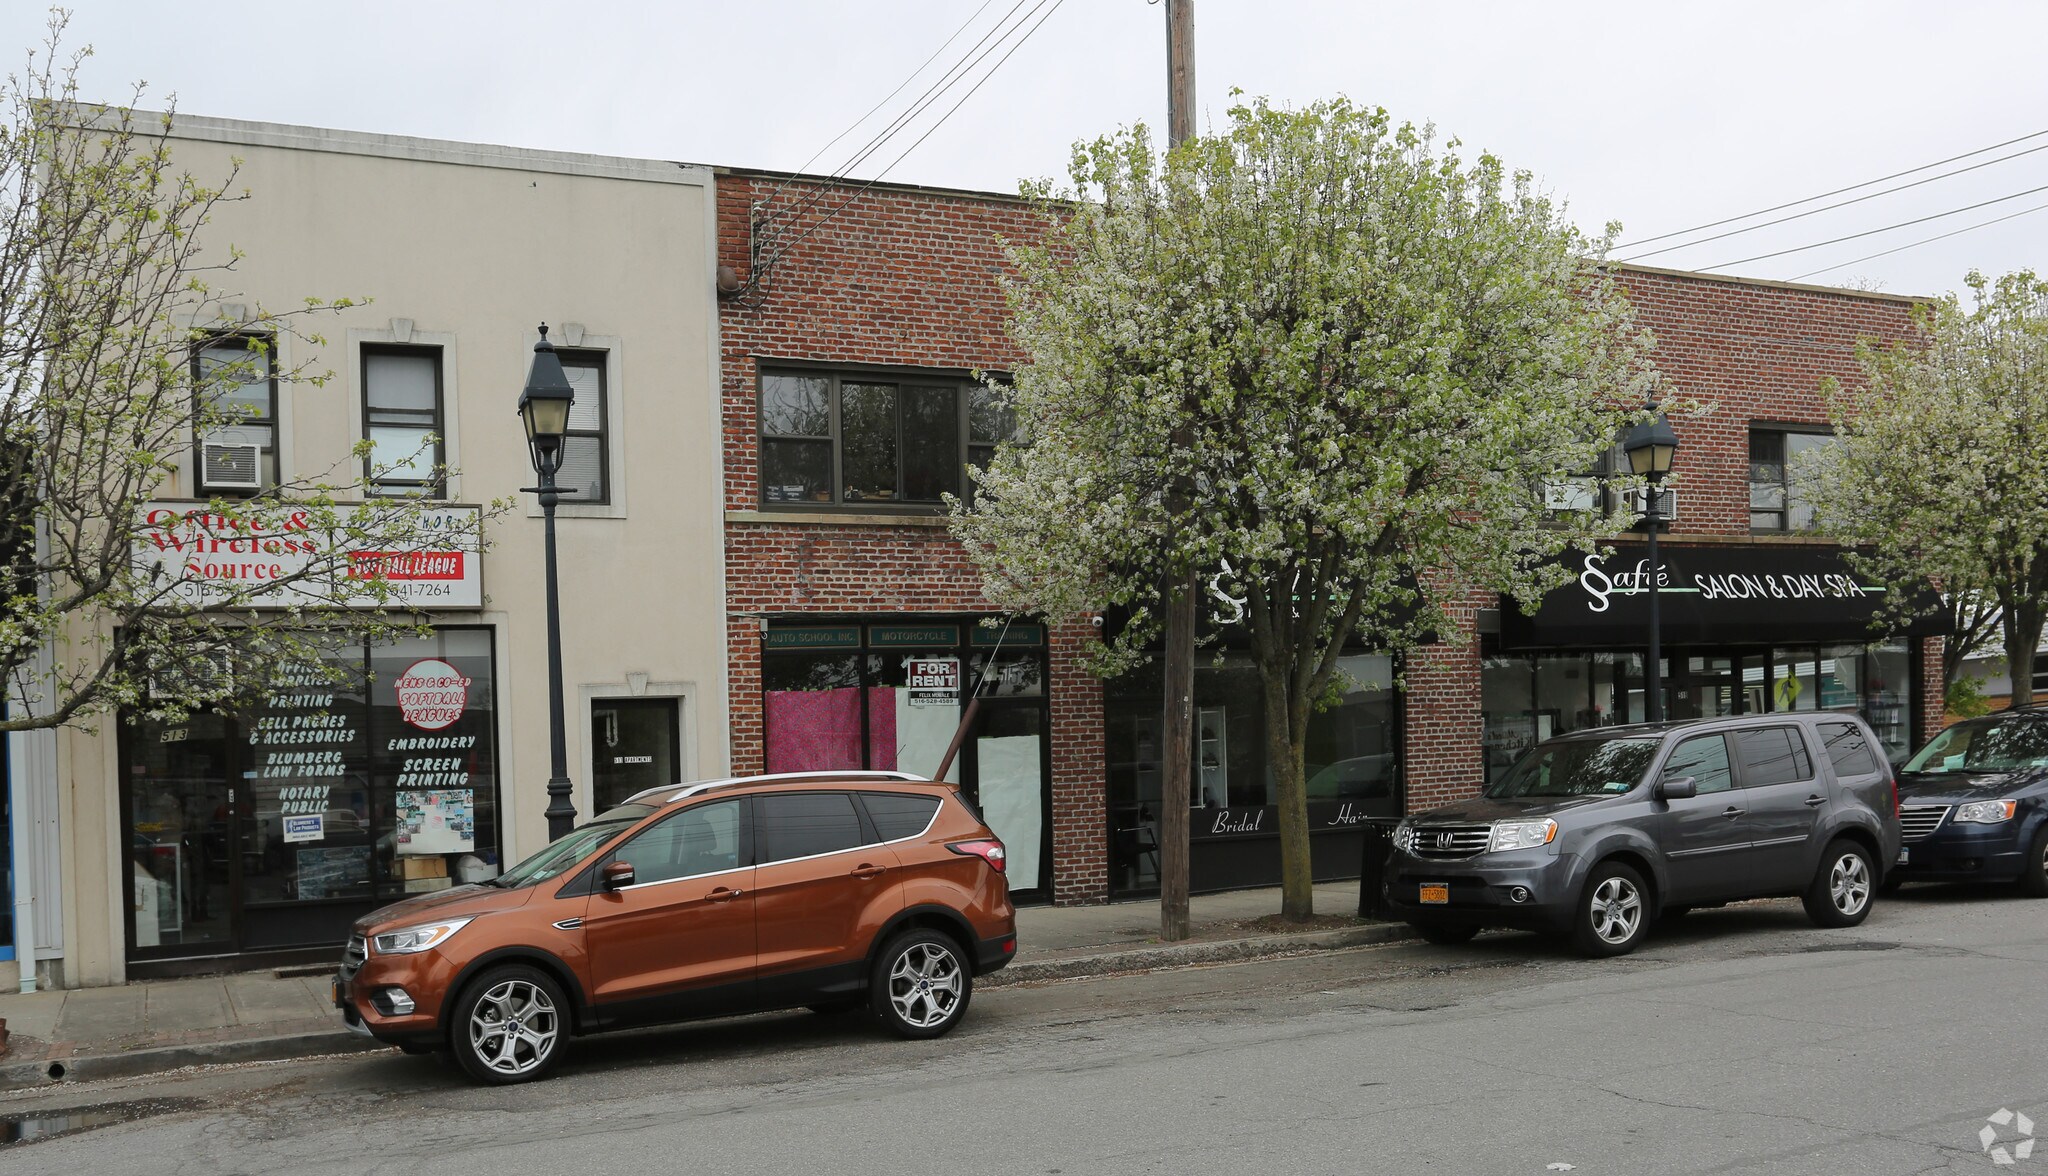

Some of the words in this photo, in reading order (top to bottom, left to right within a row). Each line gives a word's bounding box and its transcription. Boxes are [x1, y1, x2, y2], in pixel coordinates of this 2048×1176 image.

[283, 511, 309, 531] &
[149, 532, 318, 553] Wireless
[185, 556, 282, 580] Source
[413, 557, 457, 576] LEAGUE
[1694, 574, 1768, 599] SALON
[1765, 574, 1788, 599] &
[1782, 574, 1825, 599] DAY
[1824, 574, 1866, 598] SPA
[770, 633, 796, 643] AUTO
[799, 633, 833, 642] SCHOOL
[838, 632, 857, 642] INC.
[882, 631, 948, 641] MOTORCYCLE
[917, 663, 950, 675] FOR
[997, 665, 1018, 685] 515
[393, 678, 425, 688] MENS
[426, 678, 436, 688] &
[437, 677, 472, 687] CO-ED
[912, 675, 956, 687] RENT
[269, 694, 334, 708] PRINTING
[401, 692, 466, 706] SOFTBALL
[403, 708, 463, 722] LEAGUES
[258, 717, 288, 730] CELL
[292, 715, 347, 729] PHONES
[161, 730, 187, 741] 513
[249, 732, 259, 745] &
[263, 729, 355, 745] ACCESSORIES
[387, 736, 475, 750] EMBROIDERY
[267, 751, 342, 765] BLUMBERG
[403, 758, 461, 772] SCREEN
[263, 765, 292, 778] LAW
[297, 764, 346, 777] FORMS
[396, 773, 469, 787] PRINTING
[279, 785, 330, 800] NOTARY
[281, 800, 329, 814] PUBLIC
[1212, 810, 1264, 833] Bridal
